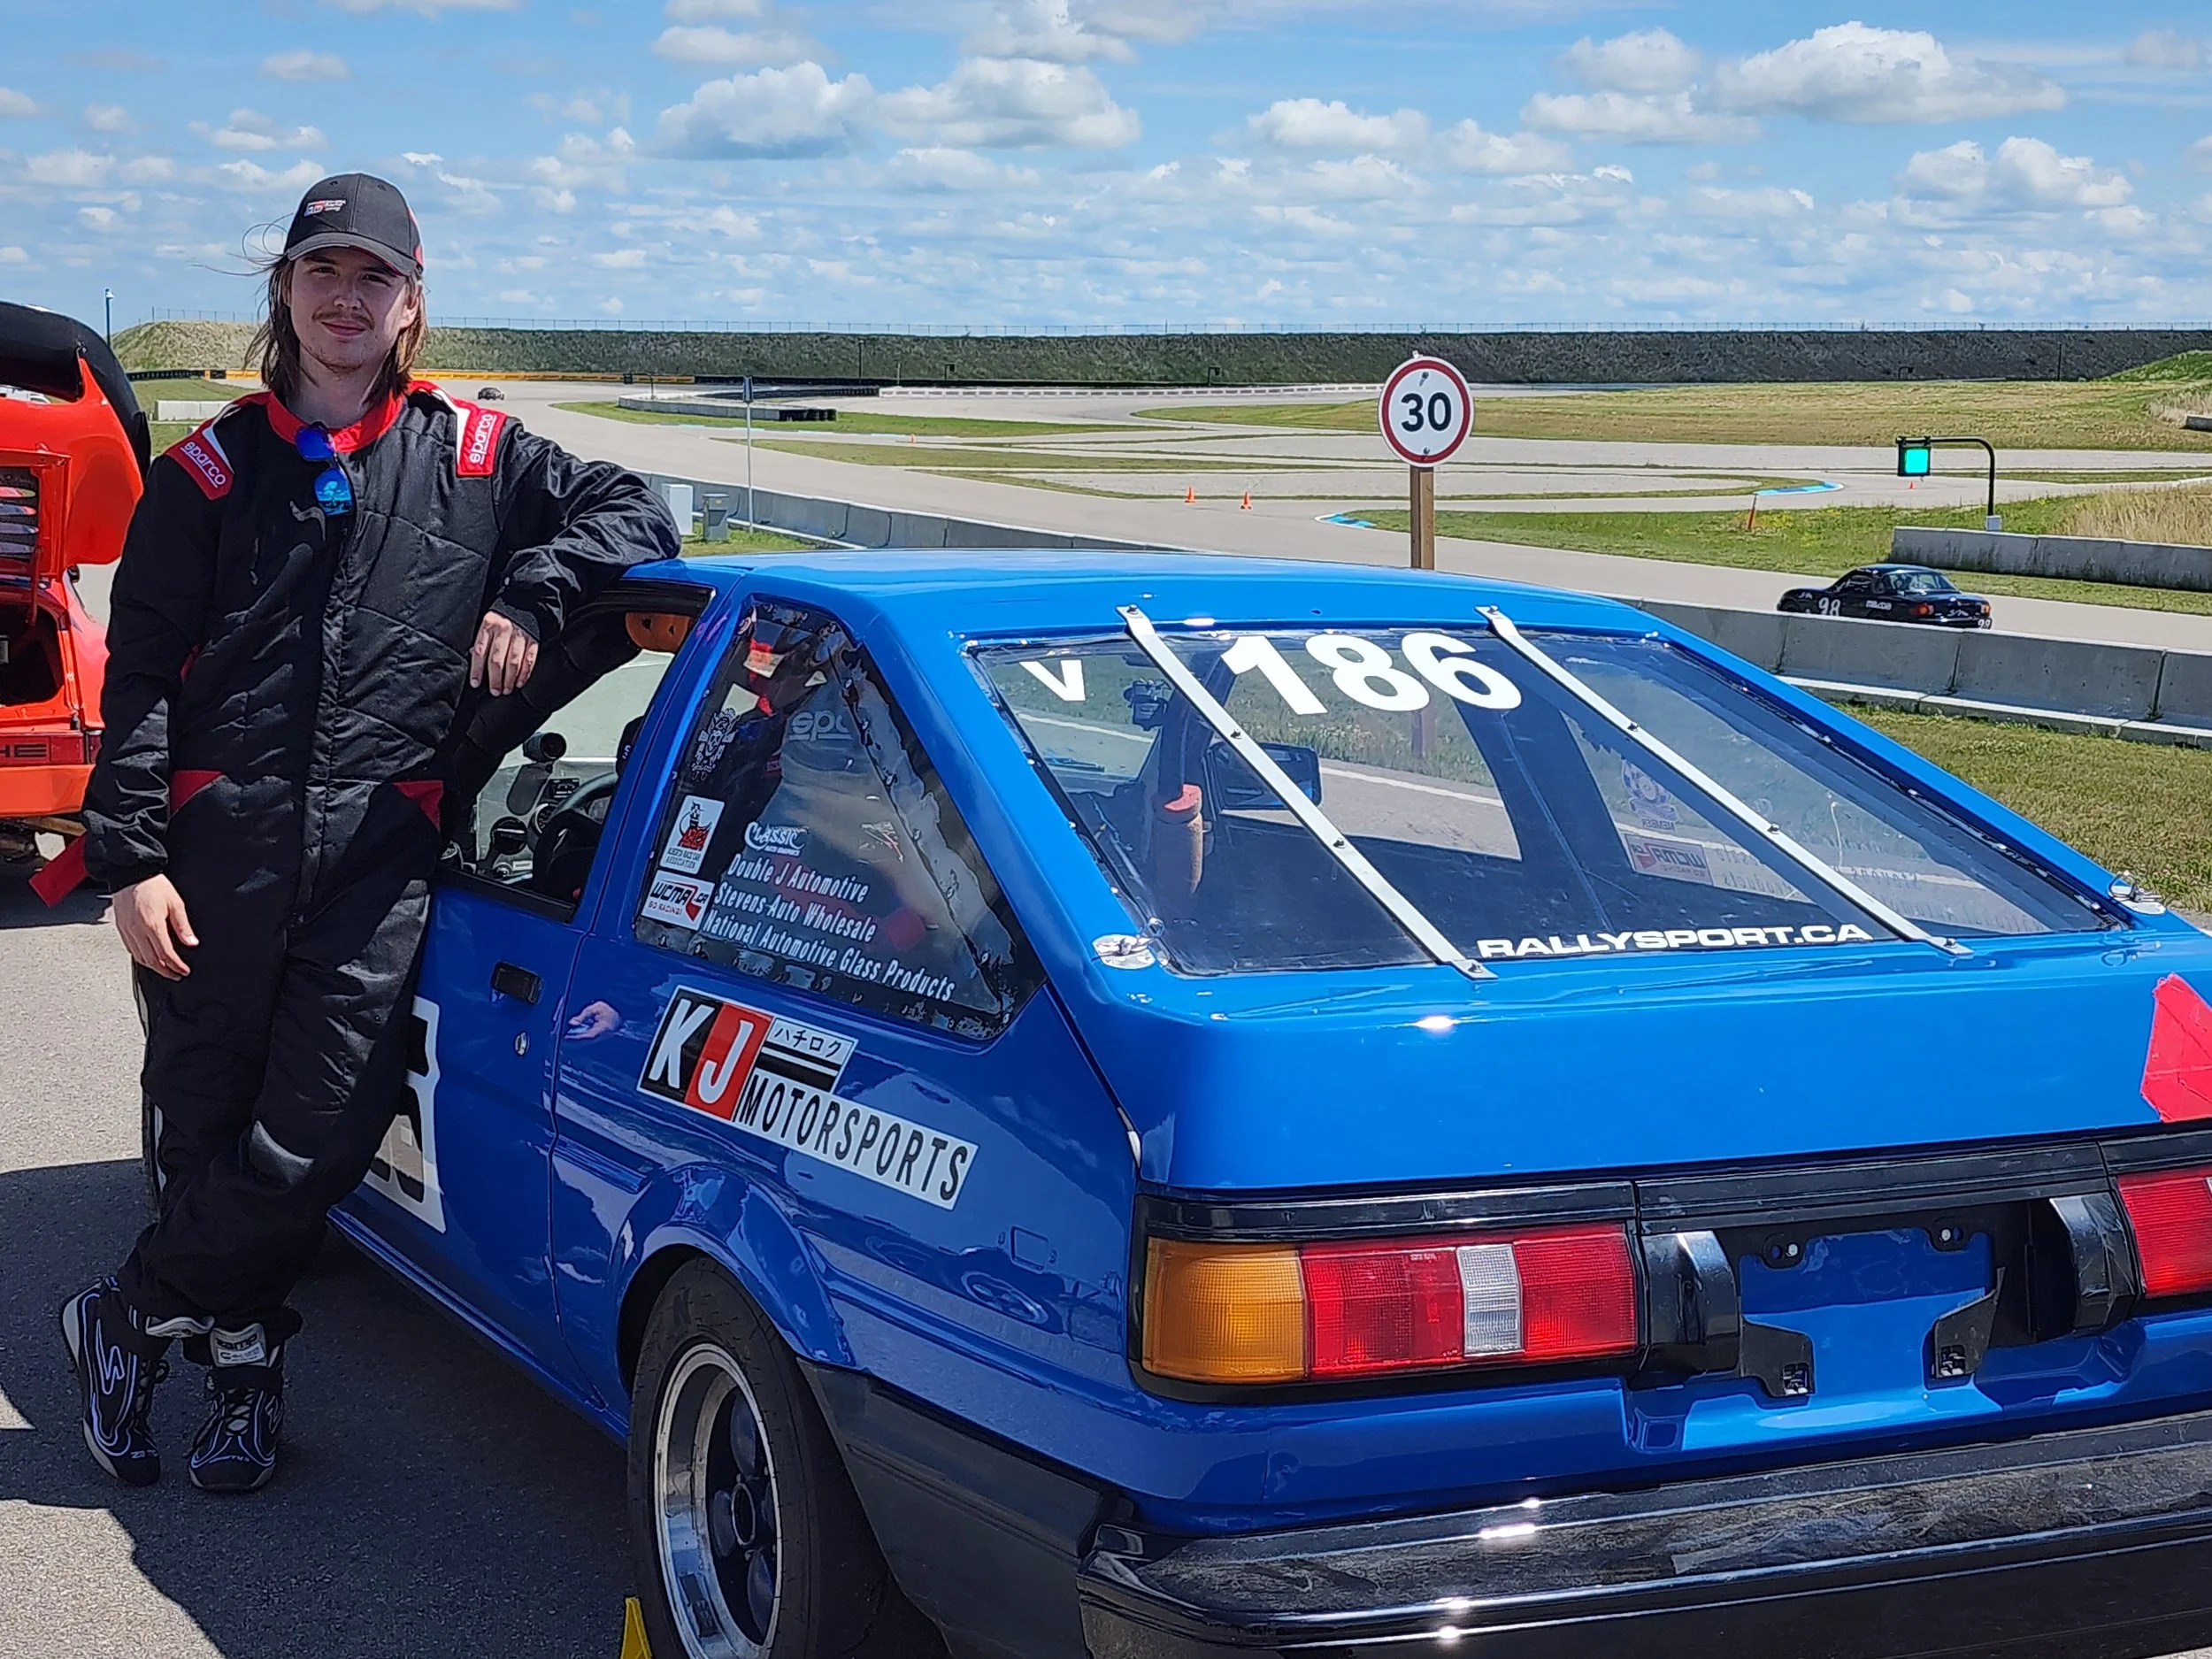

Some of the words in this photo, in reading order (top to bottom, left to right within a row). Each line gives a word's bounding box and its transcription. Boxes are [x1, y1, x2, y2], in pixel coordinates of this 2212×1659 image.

[1402, 392, 1451, 431] 30
[469, 414, 497, 465] sparco
[180, 442, 226, 488] sparco
[1818, 597, 1840, 616] 98
[1019, 659, 1086, 701] V
[1221, 633, 1521, 715] 186
[727, 853, 774, 882] Double
[775, 863, 790, 886] J
[787, 864, 869, 902] Automotive
[715, 881, 767, 914] Stevens
[803, 902, 876, 942] Wholesale
[703, 910, 762, 945] National
[758, 926, 837, 966] Automotive
[840, 947, 881, 980] Glass
[883, 958, 956, 1002] Products
[1478, 924, 1874, 958] RALLYSPORT.CA
[773, 1026, 842, 1059] ハチロク
[738, 1074, 968, 1201] MOTORSPORTS
